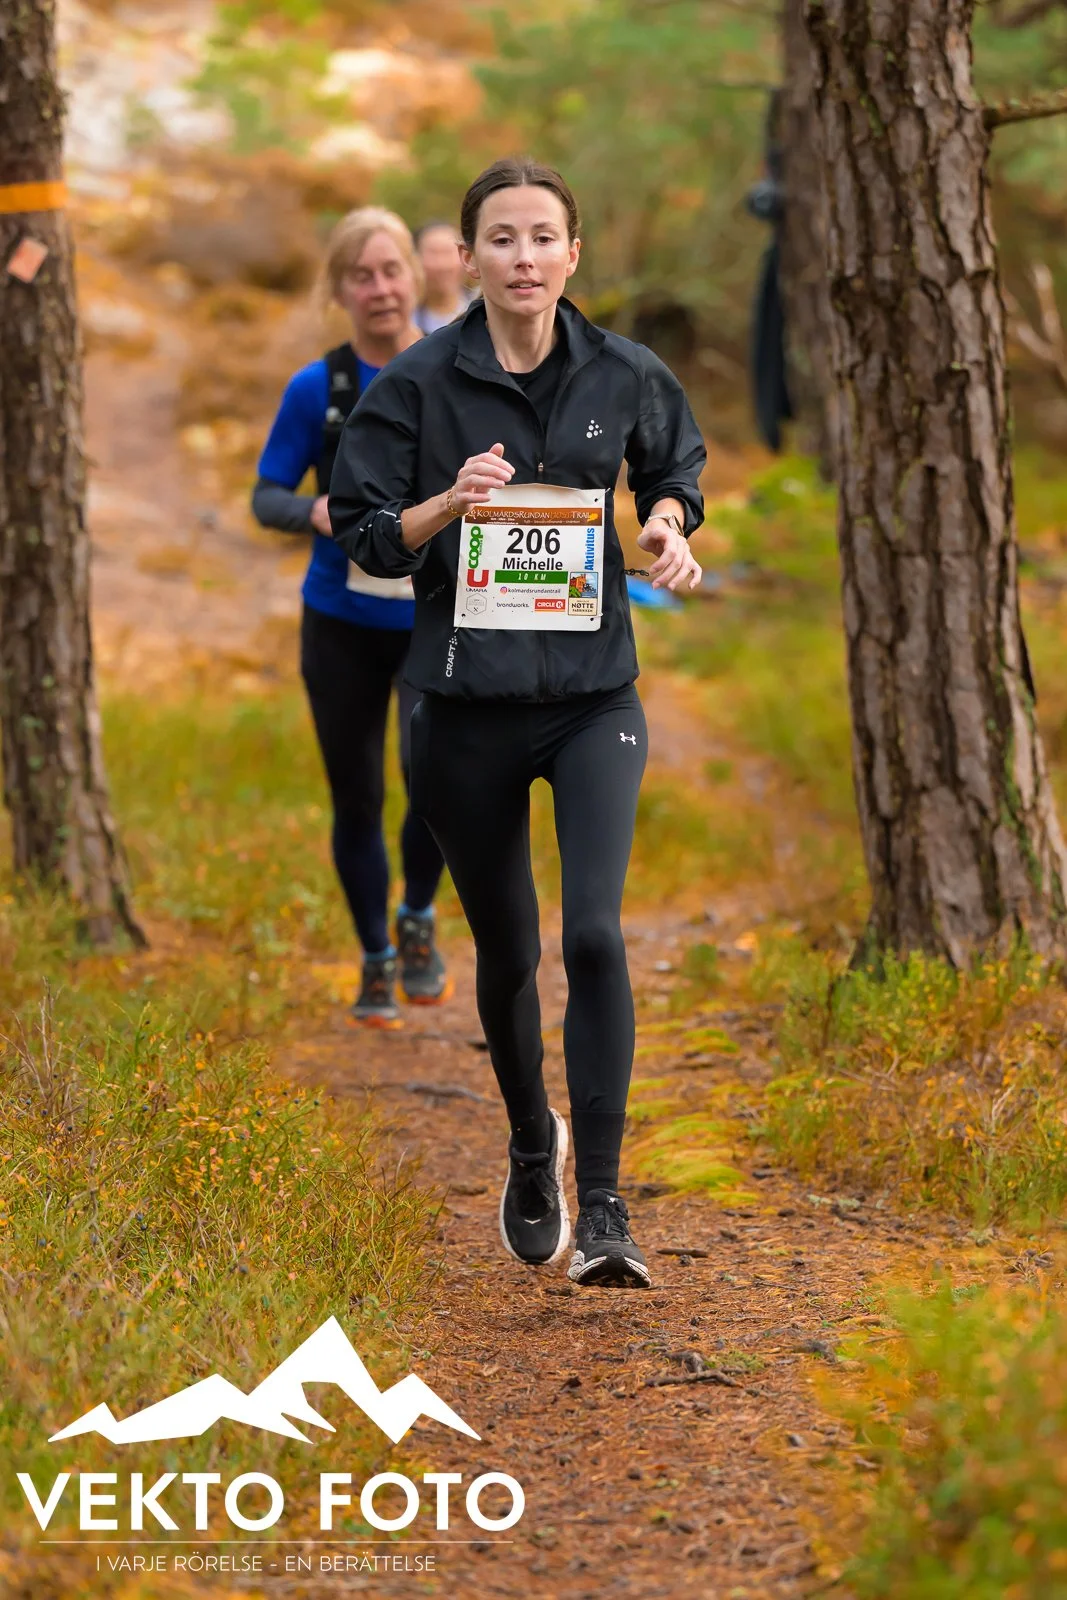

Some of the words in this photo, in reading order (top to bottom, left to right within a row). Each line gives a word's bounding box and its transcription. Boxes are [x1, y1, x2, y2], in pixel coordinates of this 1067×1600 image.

[468, 525, 483, 569] coop
[506, 527, 560, 555] 206
[584, 527, 595, 571] Aktivitus
[502, 557, 563, 571] Michelle
[517, 572, 529, 581] 10
[534, 573, 547, 581] KM
[446, 644, 456, 678] CRAFT
